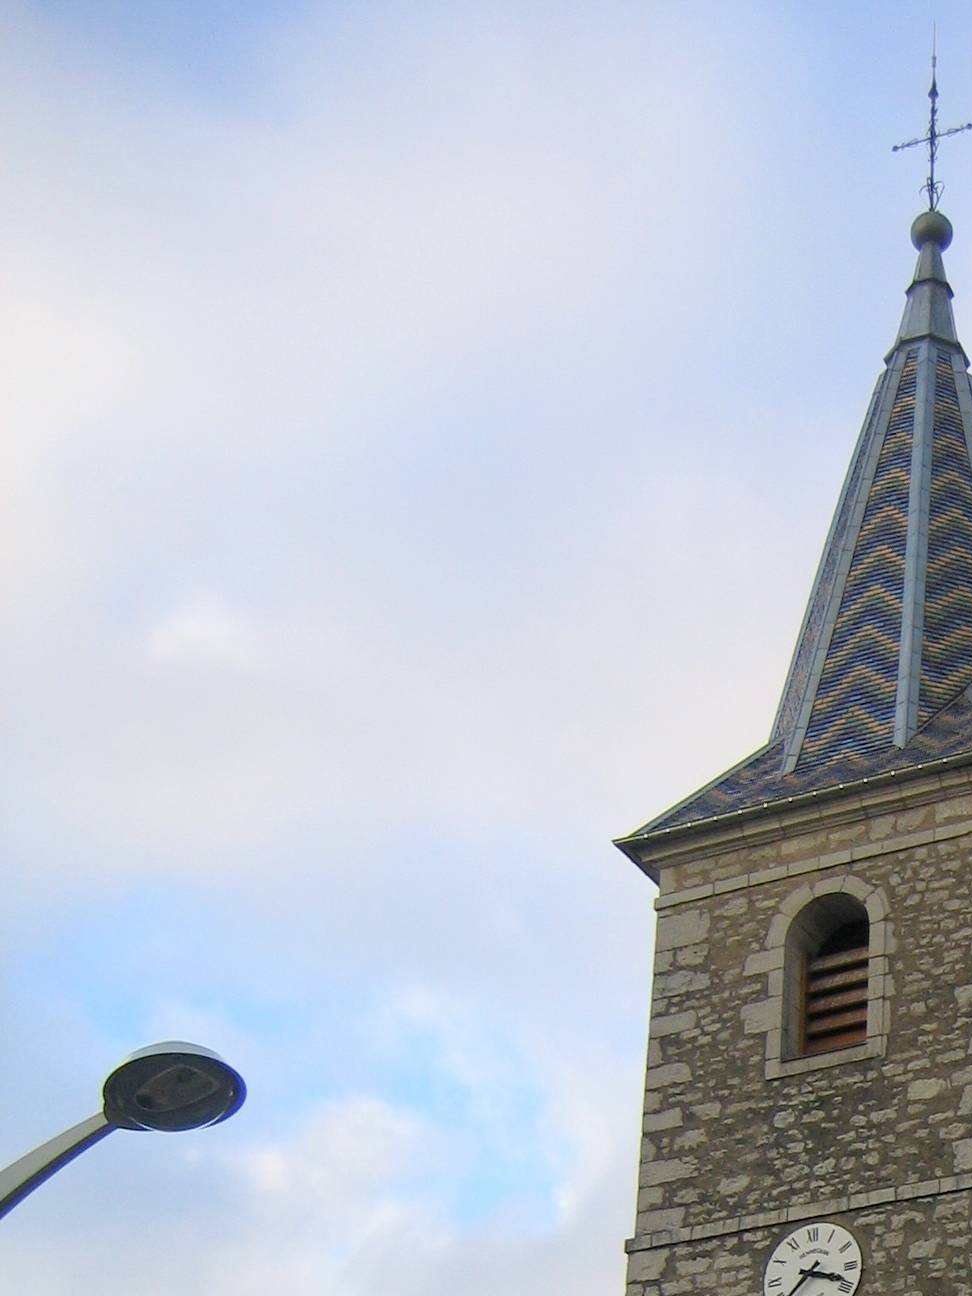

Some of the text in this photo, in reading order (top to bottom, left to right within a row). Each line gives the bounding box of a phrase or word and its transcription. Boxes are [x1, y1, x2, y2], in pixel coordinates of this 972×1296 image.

[807, 1227, 819, 1244] XII
[786, 1237, 800, 1253] XI
[838, 1240, 853, 1255] II
[773, 1257, 787, 1267] X
[843, 1260, 858, 1272] III
[768, 1277, 783, 1289] IX
